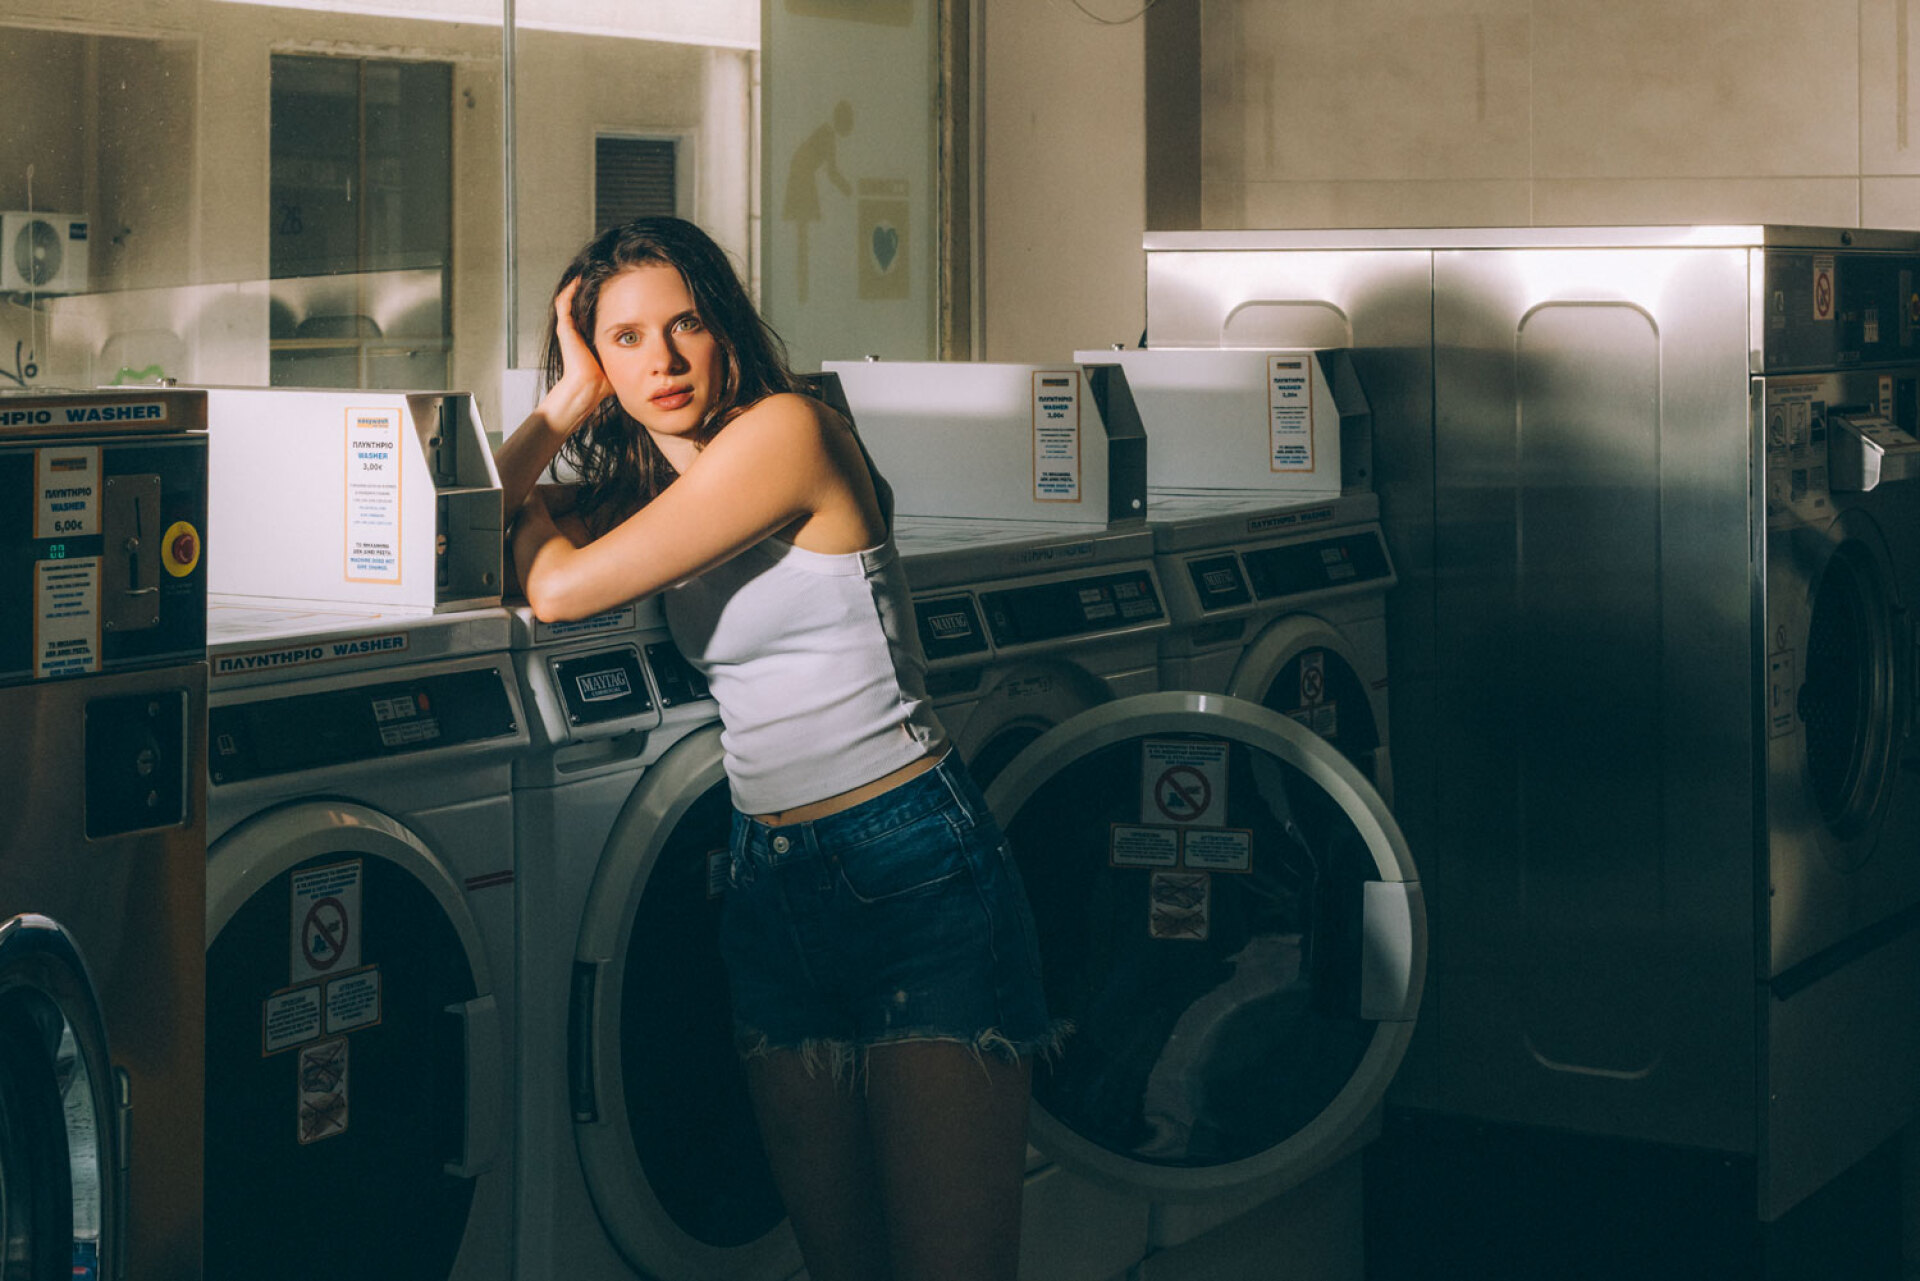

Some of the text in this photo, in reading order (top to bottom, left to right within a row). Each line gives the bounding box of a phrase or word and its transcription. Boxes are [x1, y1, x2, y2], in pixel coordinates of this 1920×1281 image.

[66, 405, 161, 422] WASHER
[352, 441, 394, 449] ΠΛΥΝΤΗΡΙΟ
[363, 463, 382, 471] 3,00€
[45, 487, 92, 499] ΠΛΥΝΤΗΡΙΟ
[51, 501, 86, 512] WASHER
[55, 520, 82, 533] 6,00€
[220, 637, 403, 671] ΠΛΥΝΤΗΡΙΟ WASHER
[580, 671, 626, 692] MAYTAG
